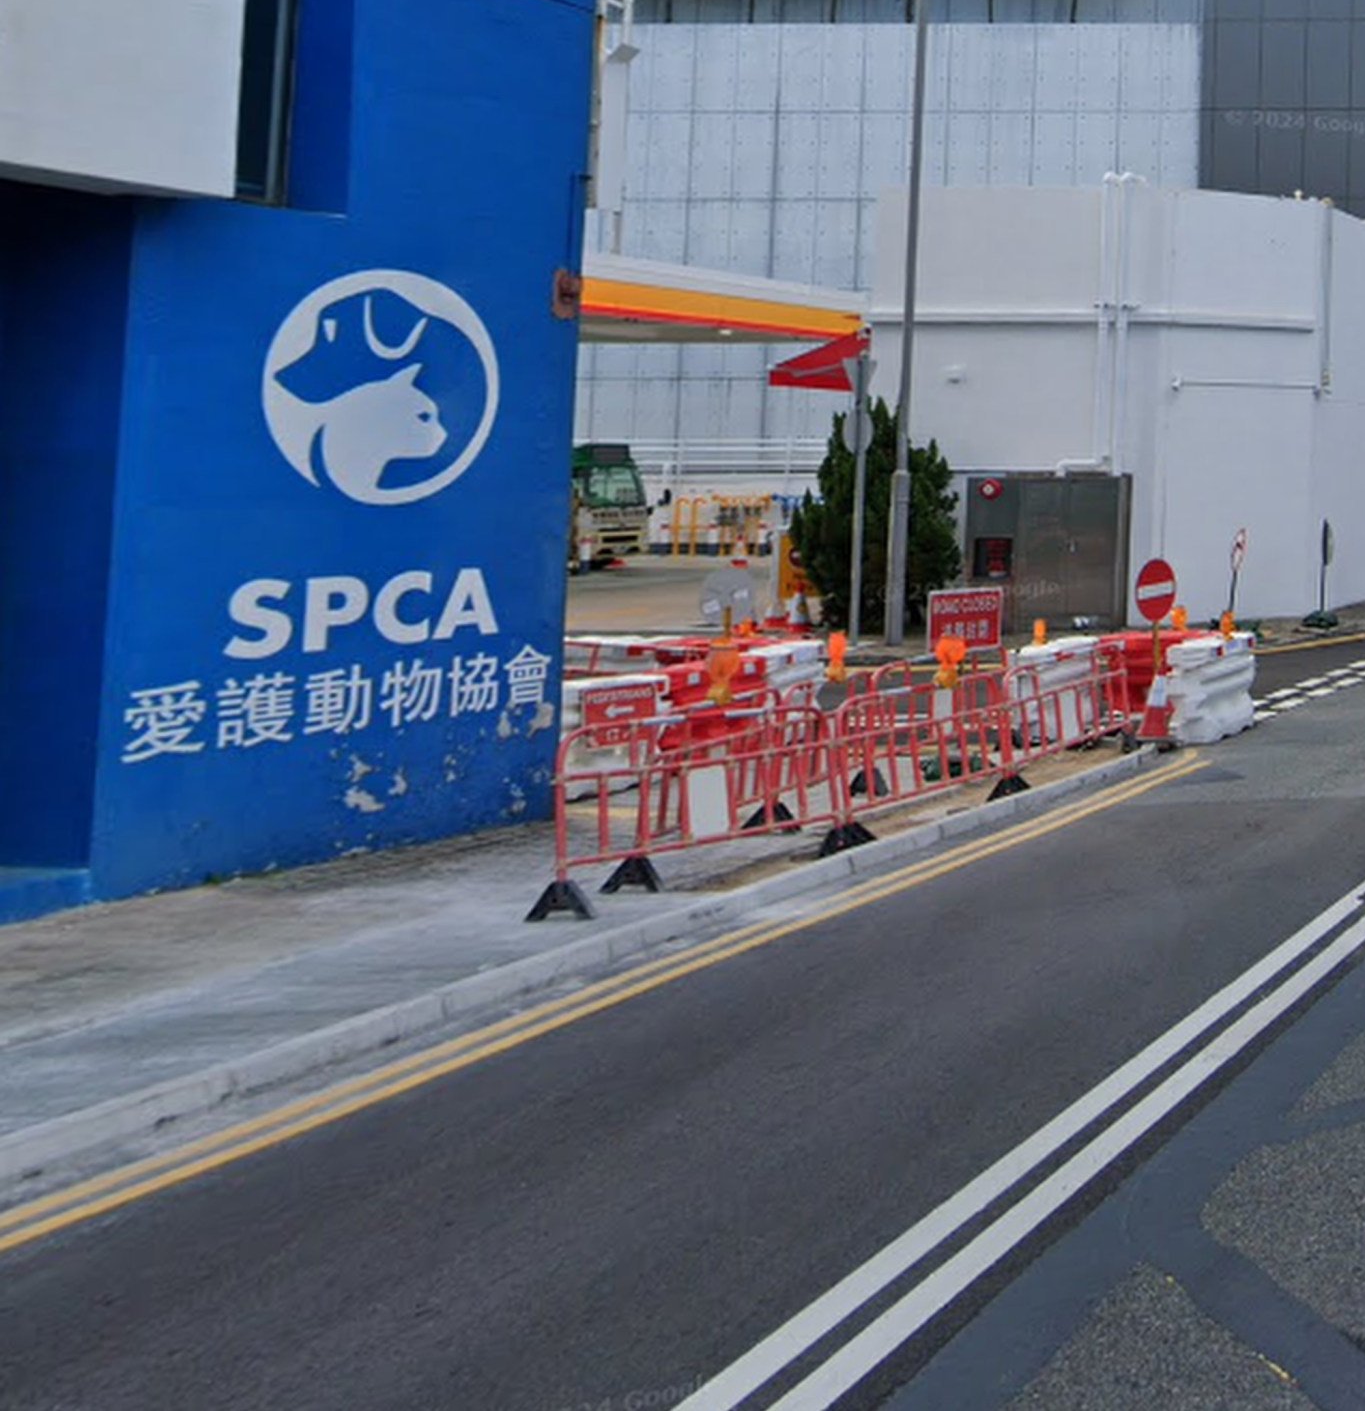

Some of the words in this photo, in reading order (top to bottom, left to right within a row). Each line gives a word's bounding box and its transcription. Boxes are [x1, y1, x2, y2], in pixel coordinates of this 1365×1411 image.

[224, 568, 500, 659] SPCA
[119, 643, 553, 765] 愛護動物協會
